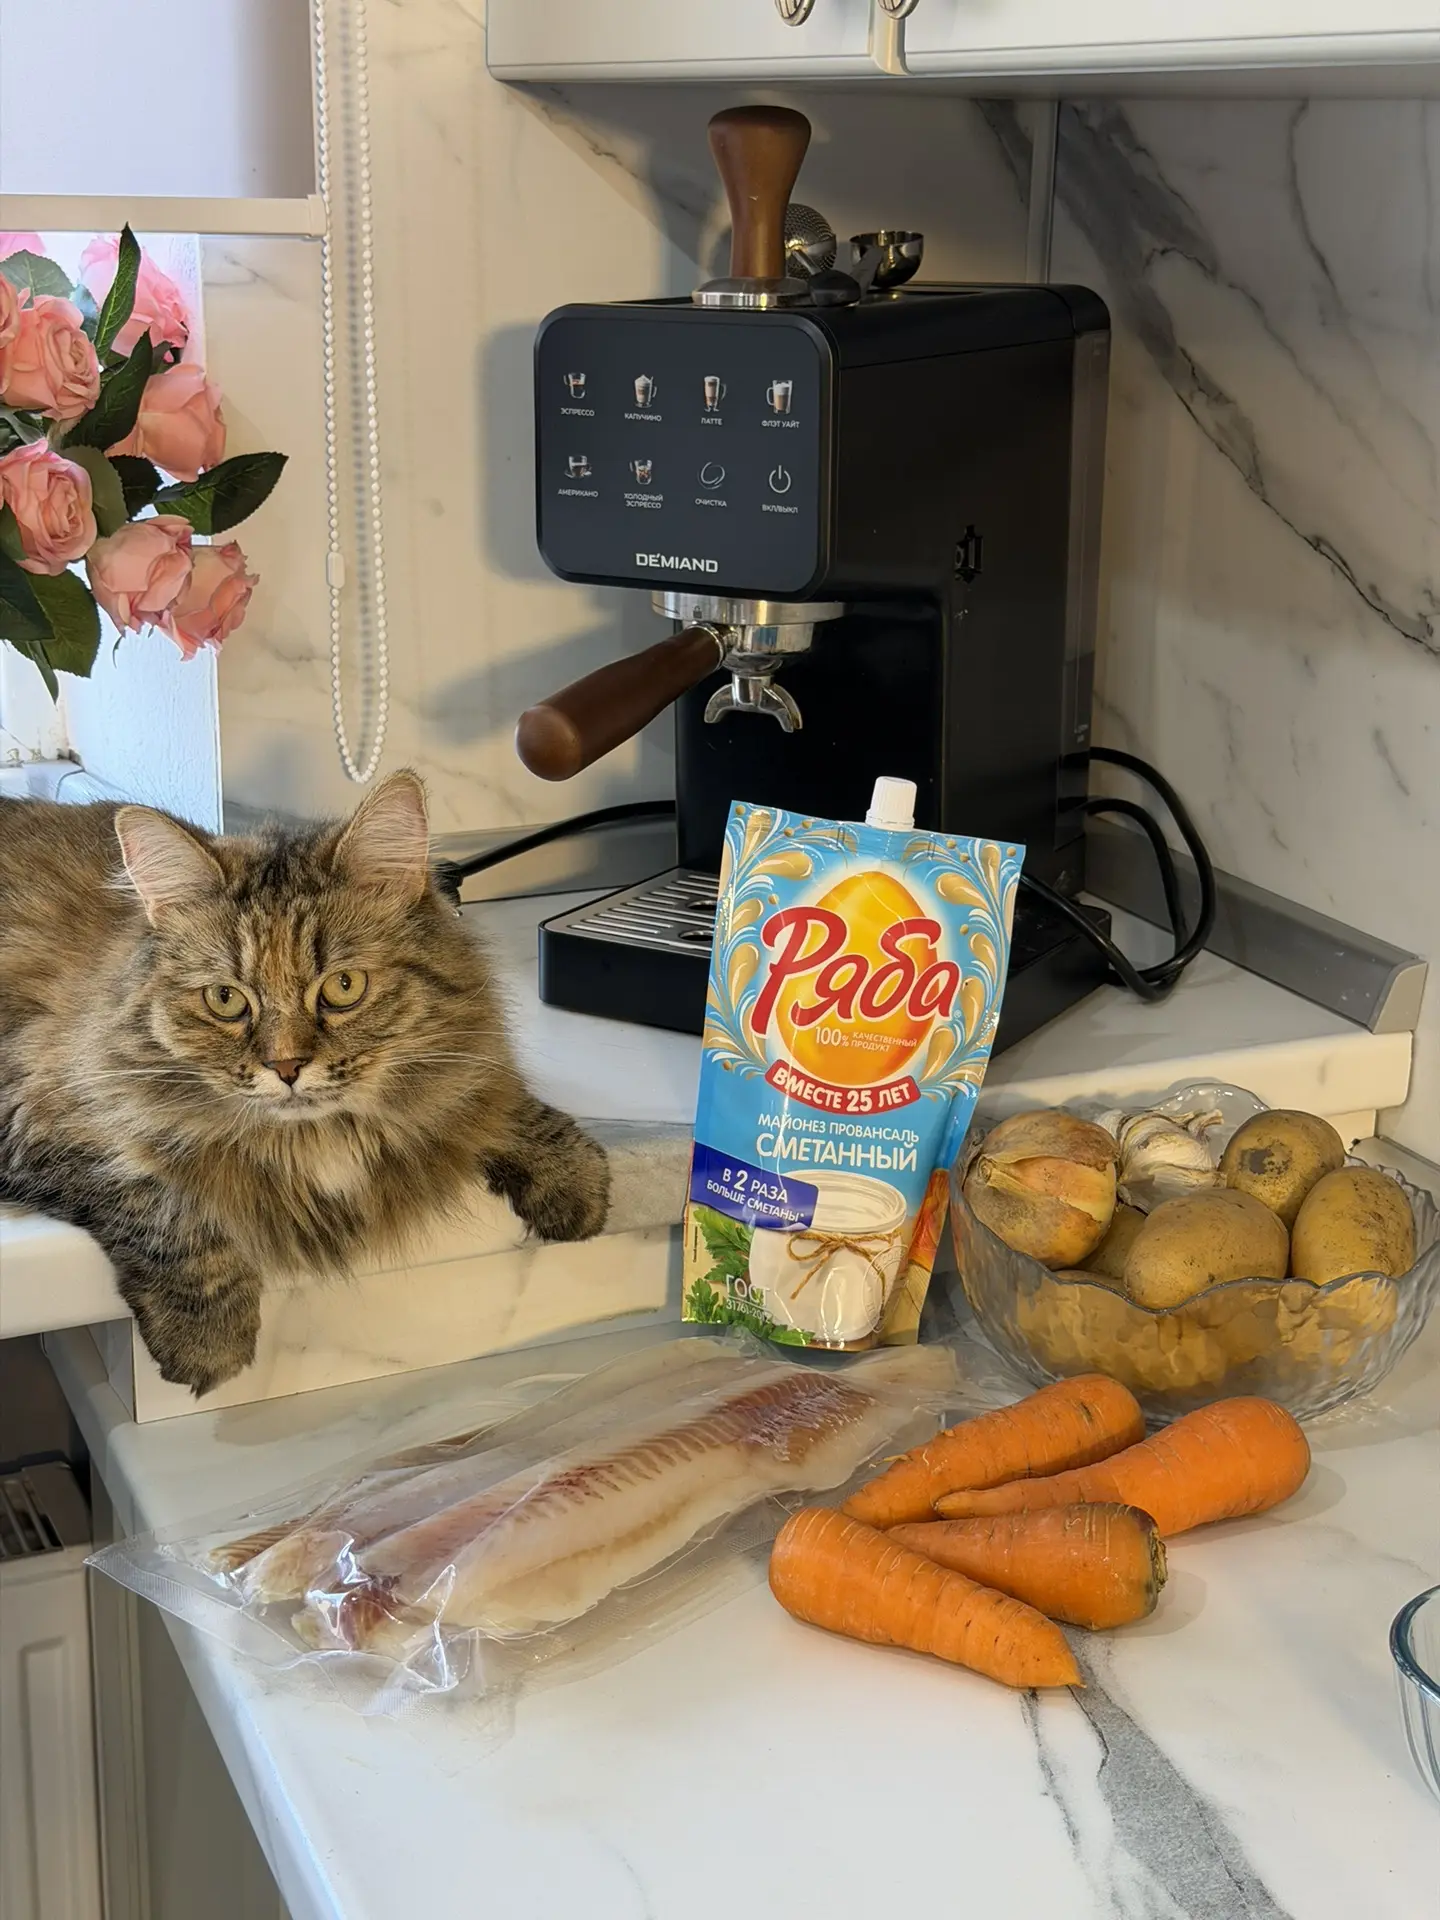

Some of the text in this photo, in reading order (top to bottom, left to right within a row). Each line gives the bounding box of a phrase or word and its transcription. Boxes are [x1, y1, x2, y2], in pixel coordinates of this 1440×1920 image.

[560, 407, 595, 417] ЭСПРЕССО
[624, 412, 662, 422] КАПУЧИНО
[701, 417, 723, 426] ЛАТТЕ
[782, 420, 800, 429] УАЙТ
[558, 488, 599, 498] АМЕРИКАНО
[624, 493, 664, 502] ХОЛОДНЫЙ
[626, 500, 662, 509] ЭСПРЕССО
[695, 498, 728, 507] ОЧИСТКА
[761, 504, 799, 514] ВКЛ/ВЫКЛ
[751, 906, 961, 1035] Ряба
[815, 1026, 918, 1048] 100% КАЧЕСТВЕННЫЙ
[851, 1040, 890, 1053] ПРОДУКТ
[772, 1067, 911, 1112] ВМЕСТЕ 25 ЛЕТ
[758, 1113, 920, 1143] МАЙОНЕЗ ПРОВАНСАЛЬ
[756, 1132, 918, 1172] СМЕТАННЫЙ
[722, 1168, 788, 1203] В 2 РАЗА
[706, 1180, 746, 1205] БОЛЬШЕ
[726, 1273, 771, 1306] ГОСТ
